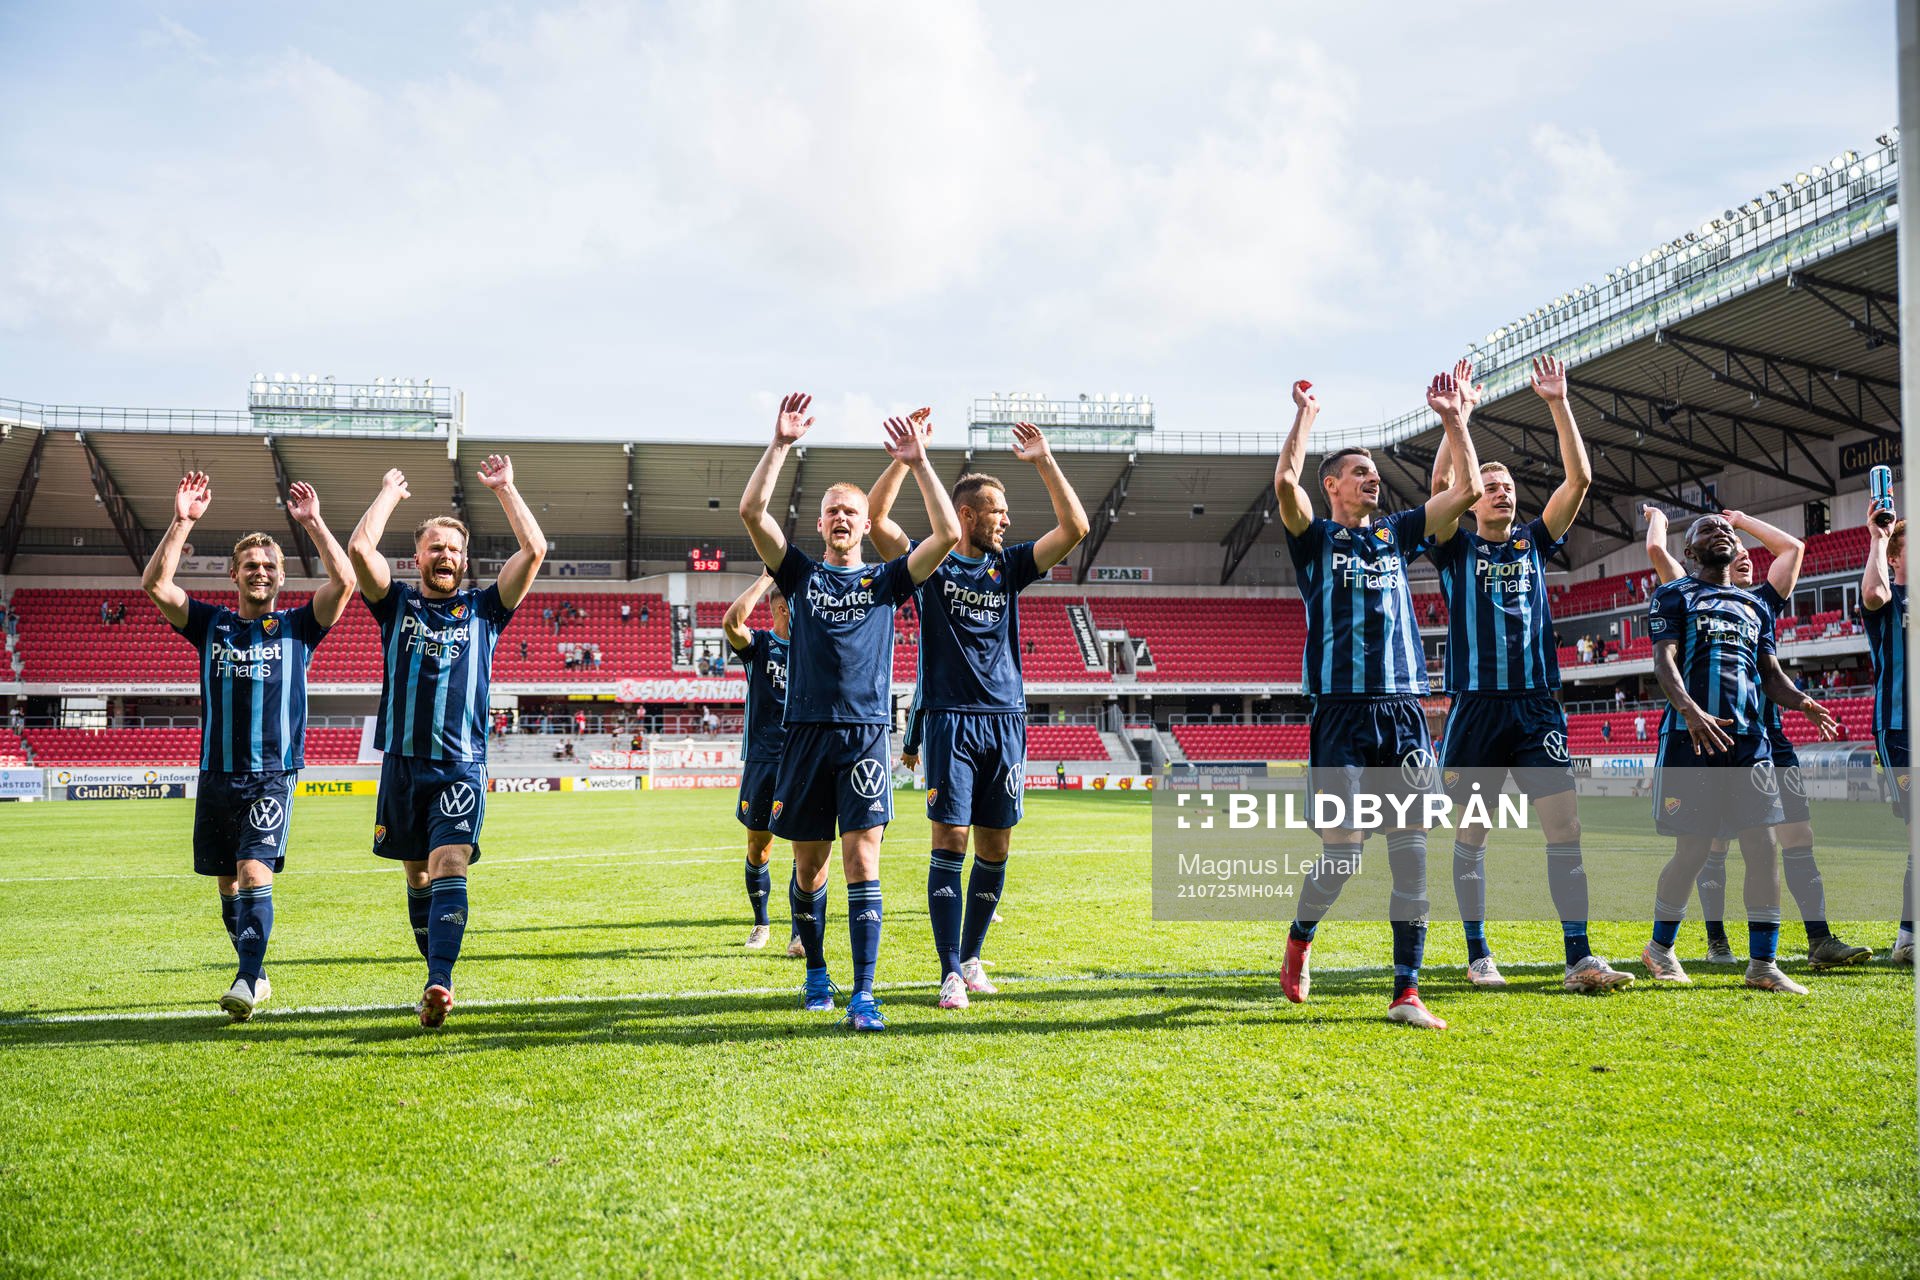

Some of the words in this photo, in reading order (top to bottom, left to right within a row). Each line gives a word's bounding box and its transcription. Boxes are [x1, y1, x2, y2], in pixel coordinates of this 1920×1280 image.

[1098, 568, 1142, 579] PEAB
[944, 580, 1007, 608] Prioritet
[950, 598, 1000, 622] Finans
[211, 642, 281, 662] Prioritet
[406, 634, 460, 659] Finans
[216, 660, 272, 677] Finans
[1611, 759, 1645, 777] STENA
[73, 772, 133, 783] infoservice
[495, 778, 551, 793] BYGG
[591, 778, 633, 789] weber
[305, 783, 353, 793] HYLTE
